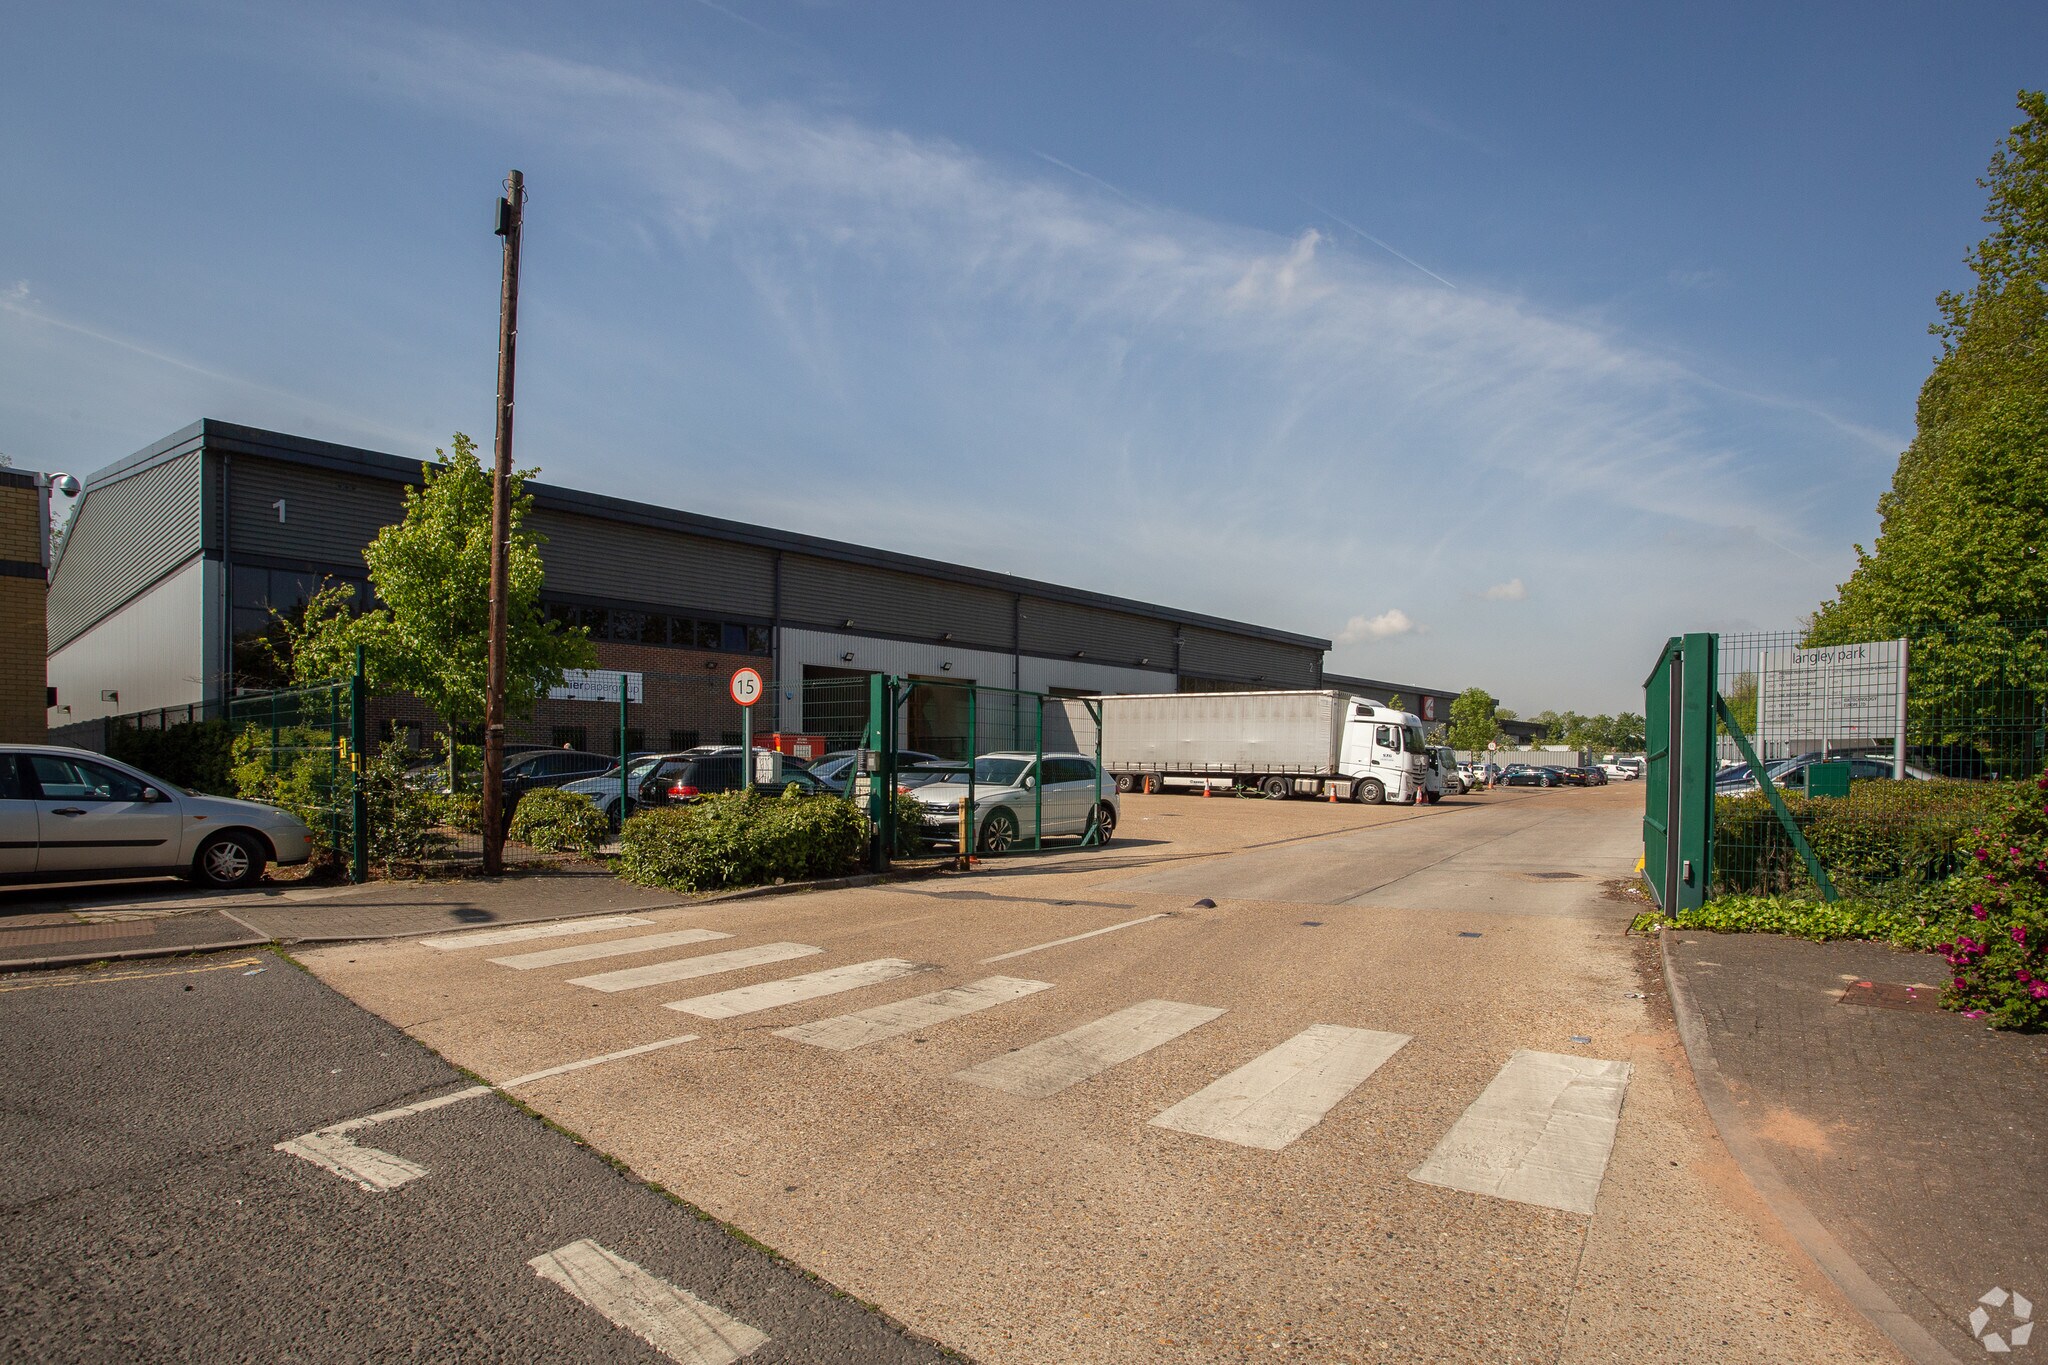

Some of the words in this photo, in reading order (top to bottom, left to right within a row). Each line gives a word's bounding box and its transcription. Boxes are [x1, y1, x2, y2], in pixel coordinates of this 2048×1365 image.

[272, 499, 286, 523] 1
[1792, 650, 1835, 666] langley
[1837, 646, 1866, 663] park
[737, 679, 754, 695] 15
